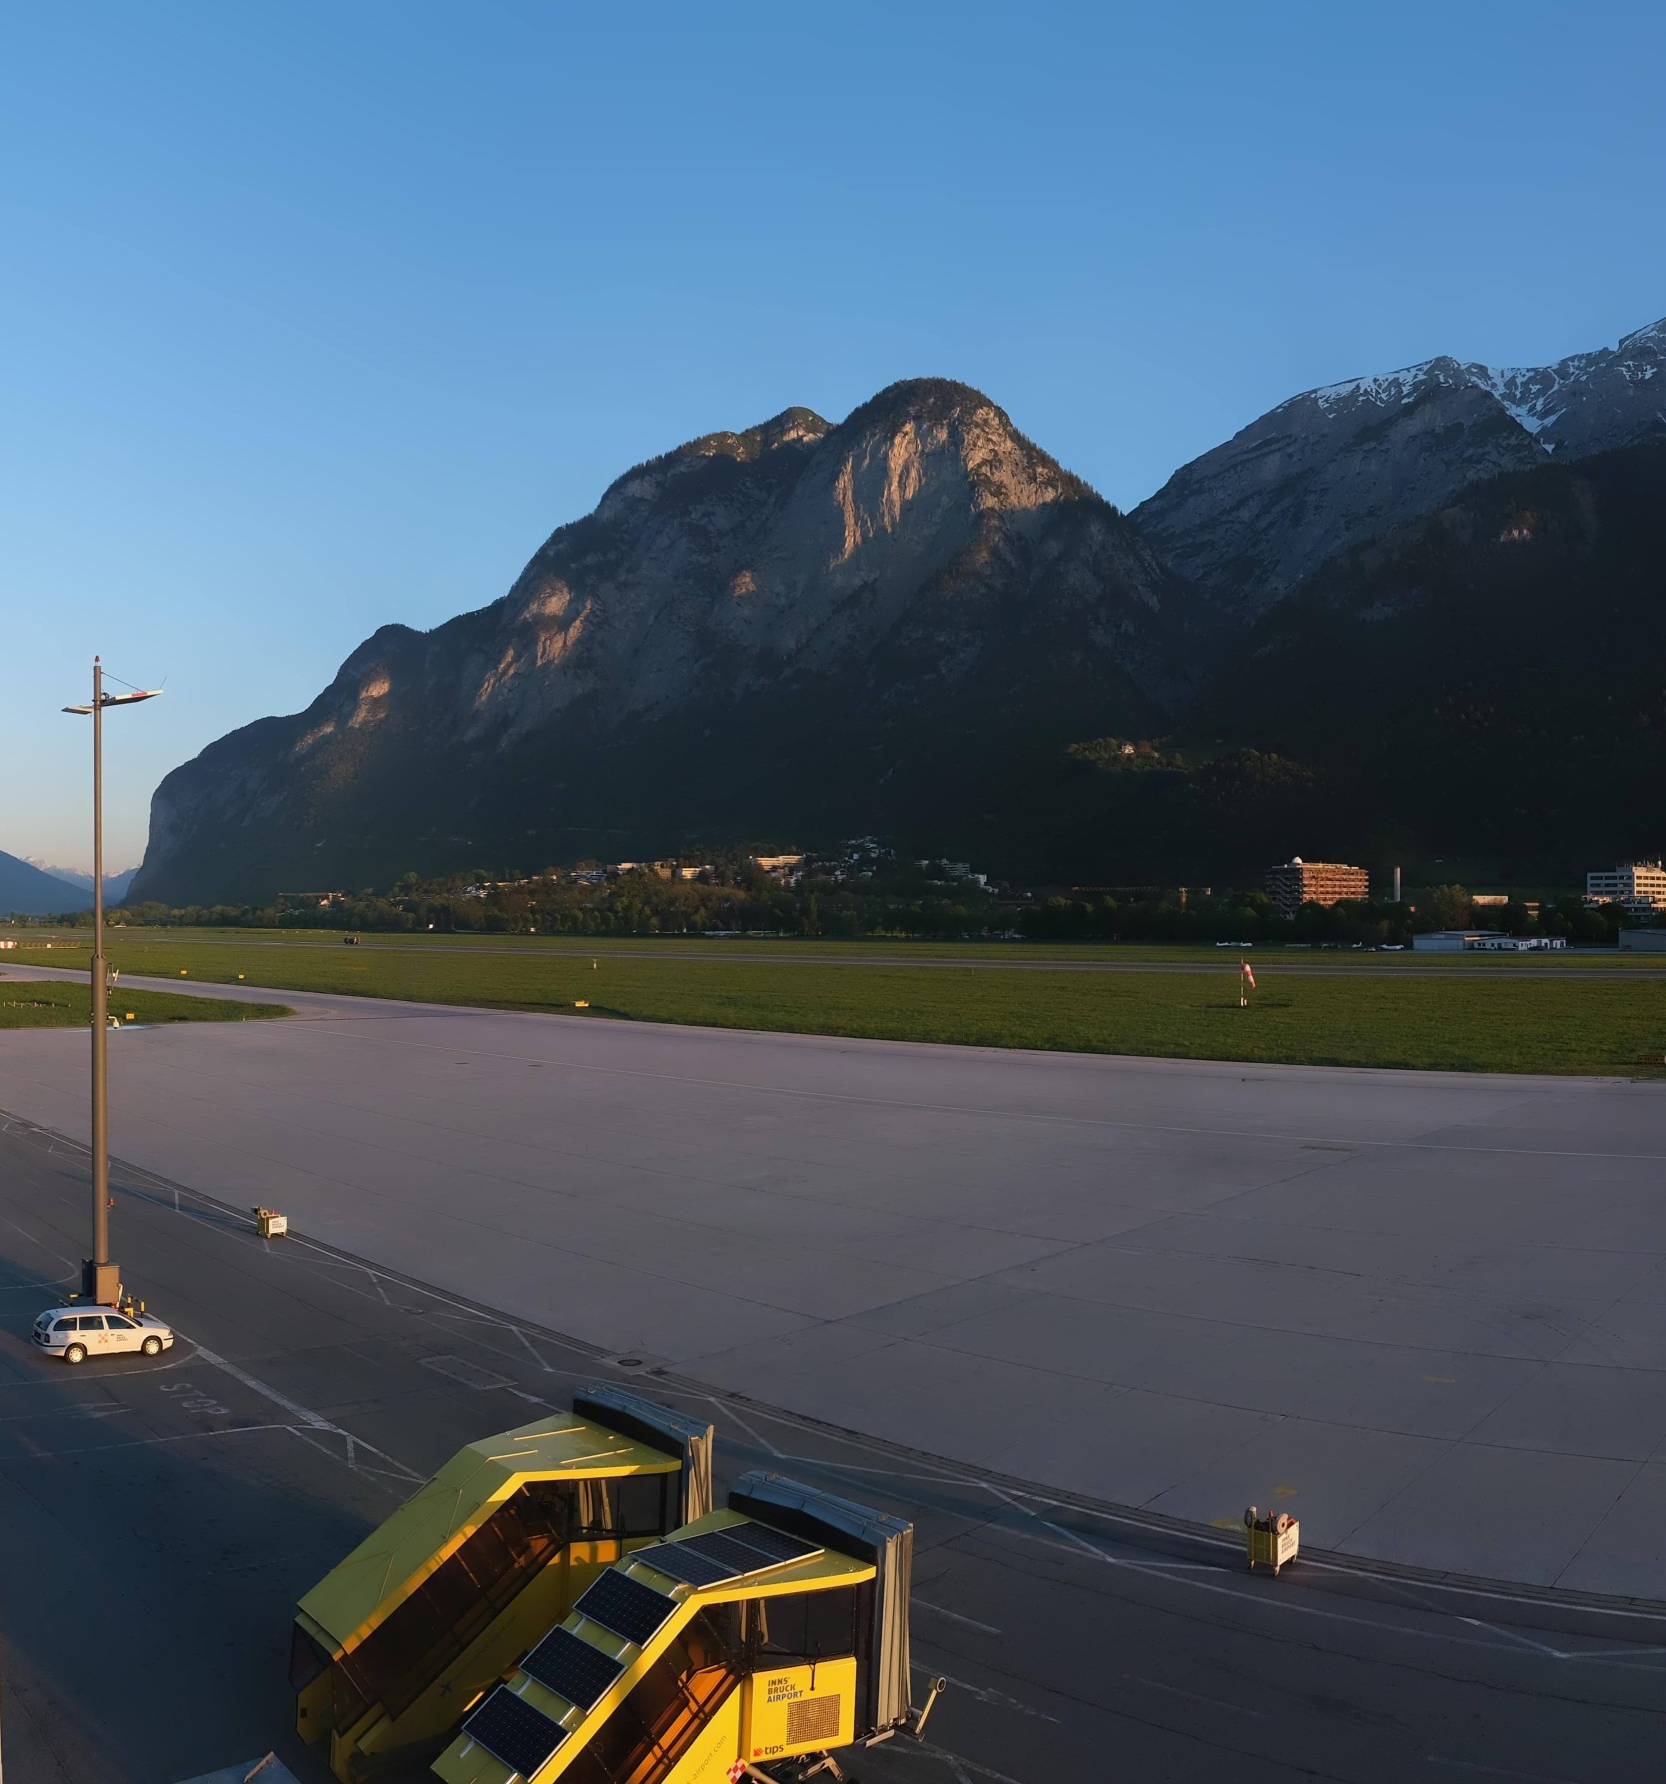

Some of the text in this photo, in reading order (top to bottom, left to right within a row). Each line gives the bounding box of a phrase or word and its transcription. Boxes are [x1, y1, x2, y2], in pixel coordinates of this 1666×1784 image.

[159, 1382, 230, 1415] STOP
[767, 1683, 796, 1695] BRUCK
[766, 1690, 804, 1703] AIRPORT
[764, 1744, 784, 1755] tips
